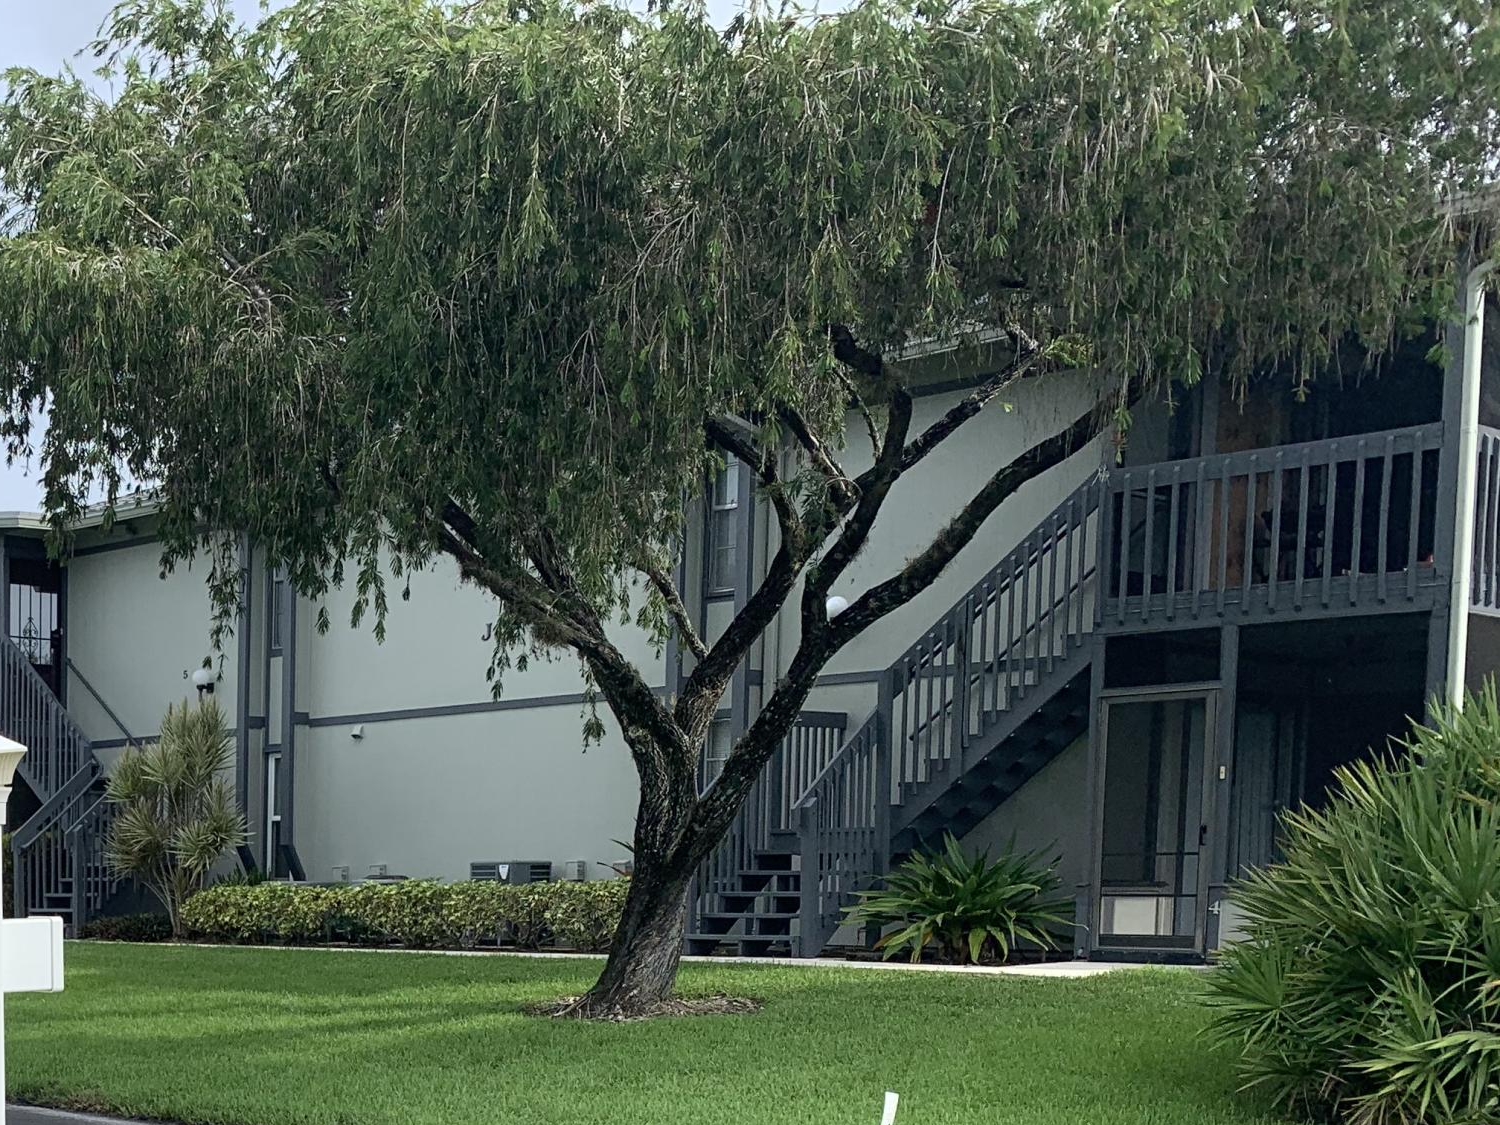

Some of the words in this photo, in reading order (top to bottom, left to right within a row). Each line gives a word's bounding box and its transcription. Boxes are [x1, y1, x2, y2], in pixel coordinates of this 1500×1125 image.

[481, 622, 493, 642] J
[183, 670, 188, 680] 5
[1208, 900, 1220, 915] 4
